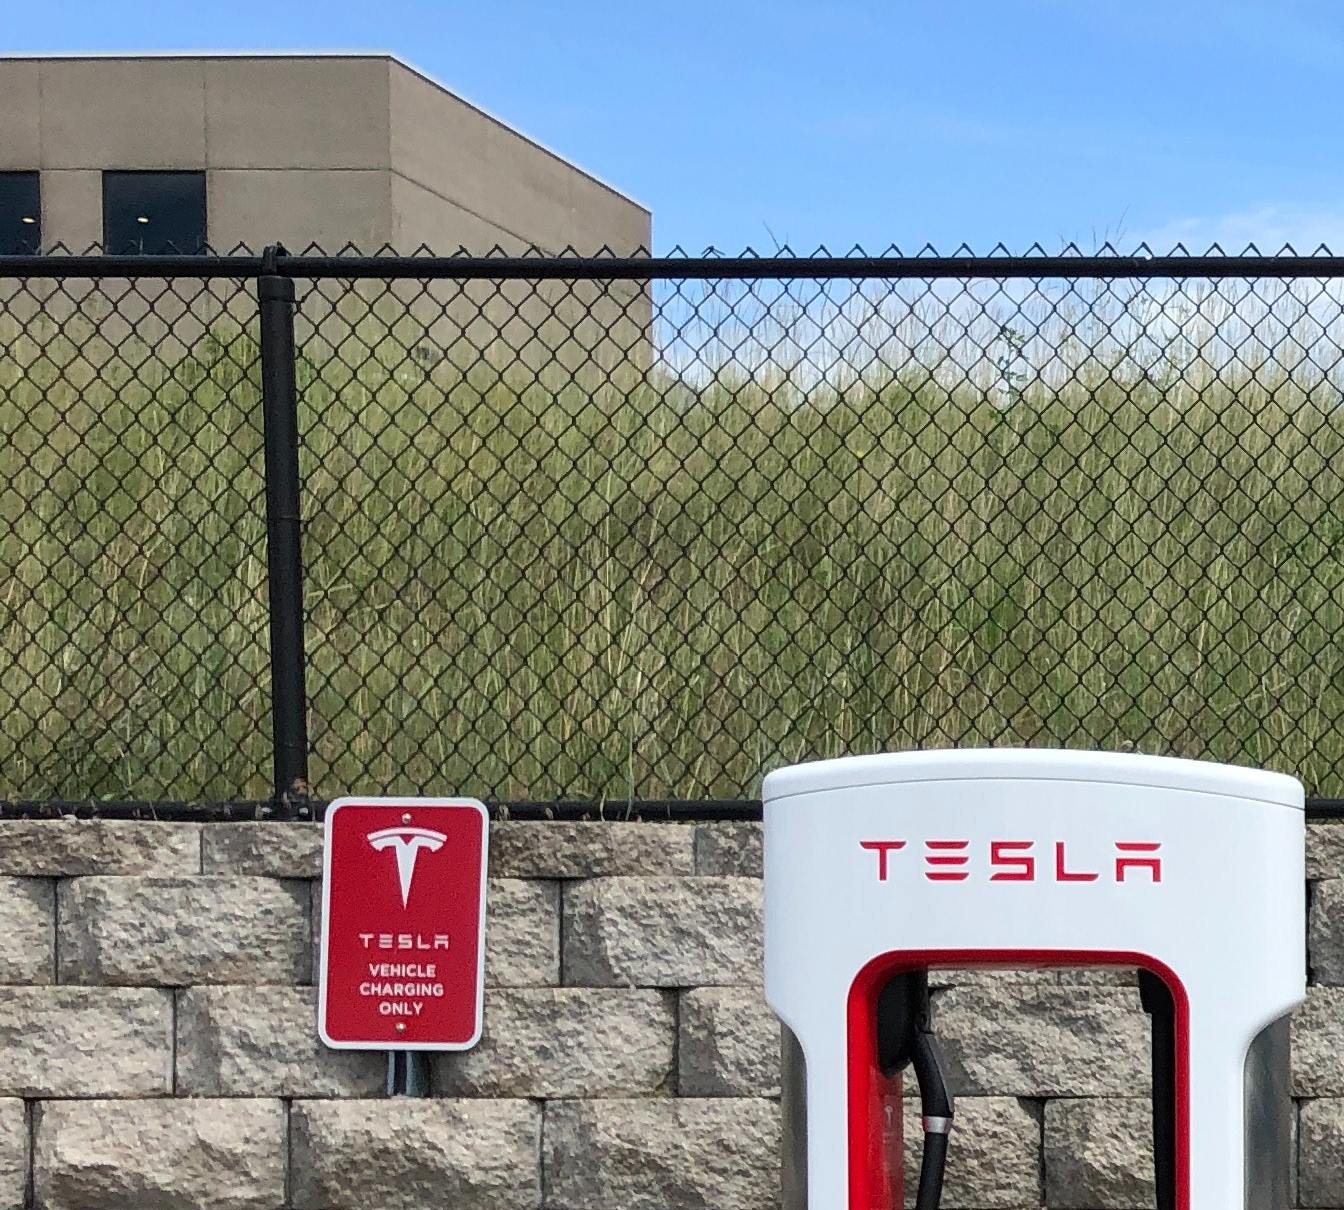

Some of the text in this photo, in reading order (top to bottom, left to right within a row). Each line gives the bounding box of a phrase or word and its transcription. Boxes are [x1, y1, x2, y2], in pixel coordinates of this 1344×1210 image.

[859, 840, 1161, 883] TESLA
[359, 933, 451, 949] TESLA
[368, 963, 437, 978] VEHICLE
[359, 982, 445, 997] CHARGING
[379, 1001, 423, 1016] ONLY
